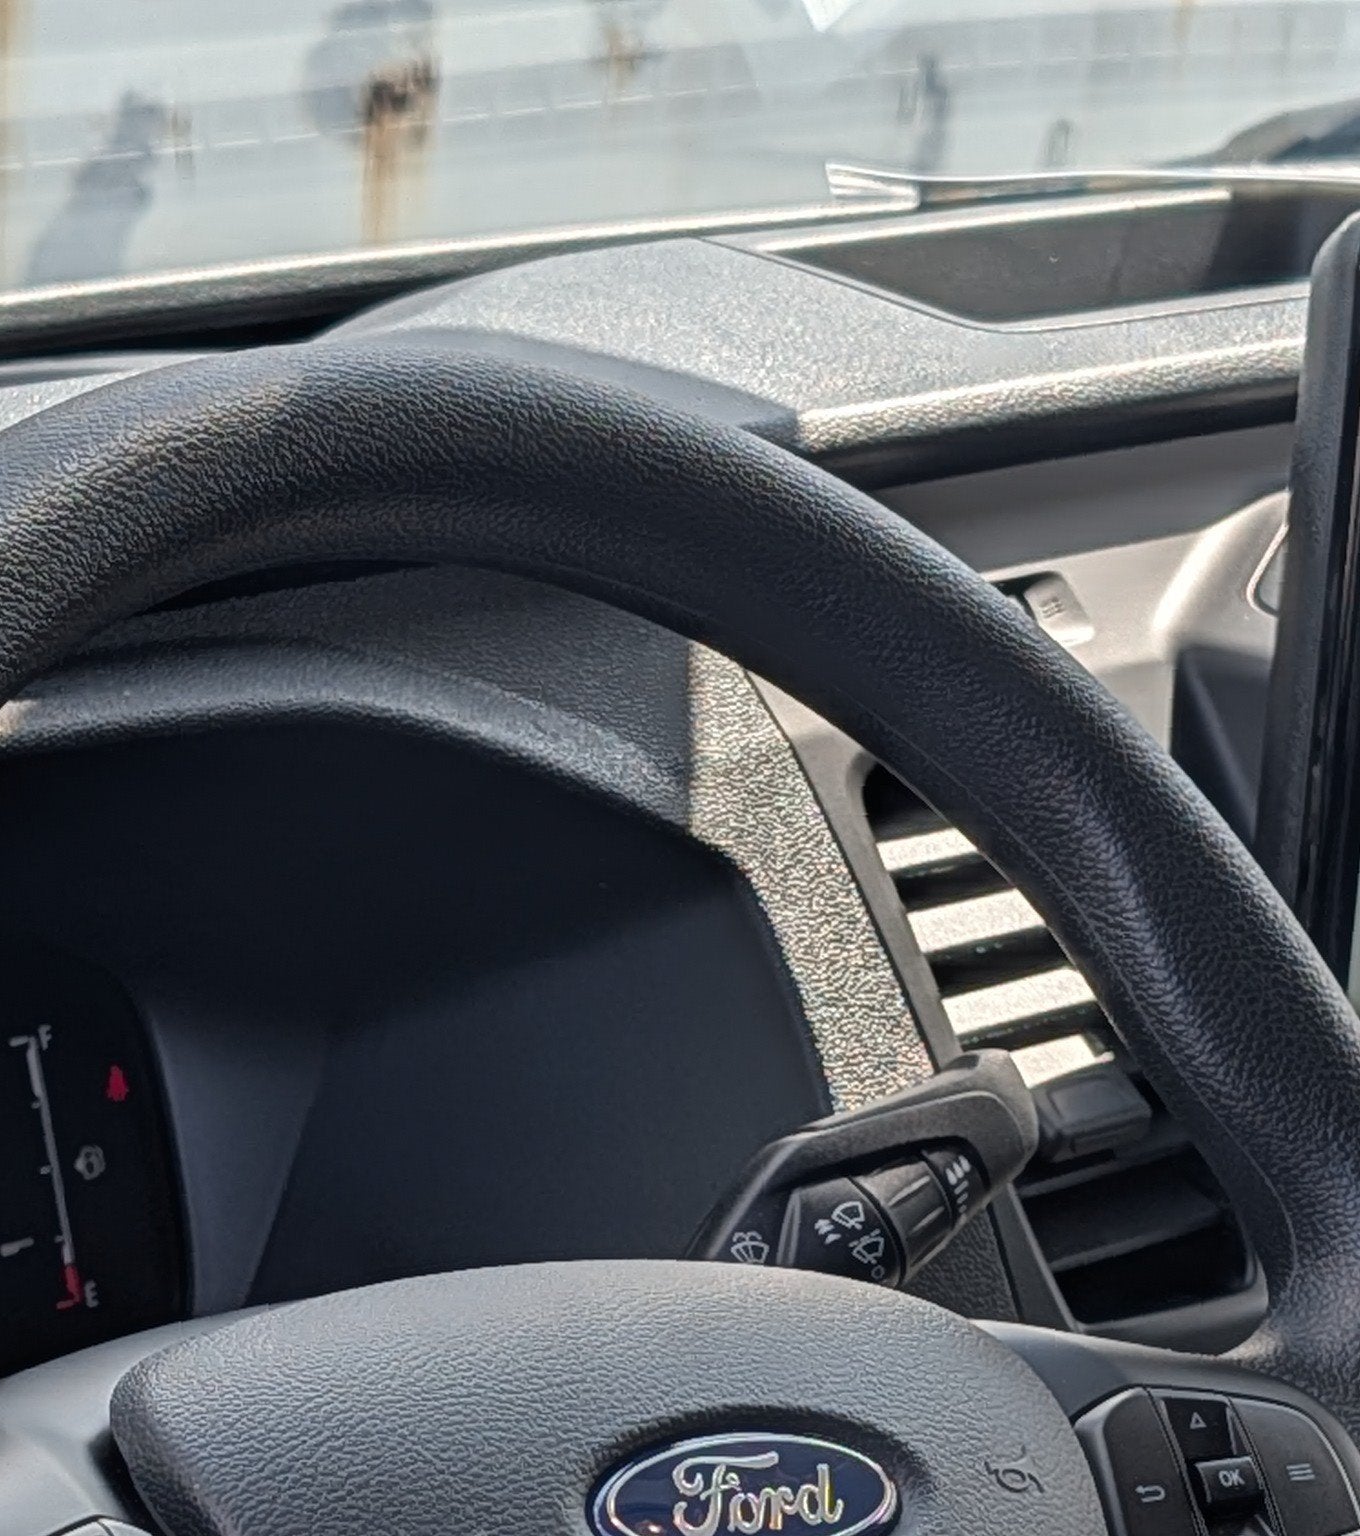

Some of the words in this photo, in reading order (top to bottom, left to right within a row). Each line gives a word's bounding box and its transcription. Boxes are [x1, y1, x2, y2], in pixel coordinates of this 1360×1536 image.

[38, 1024, 52, 1050] F
[84, 1281, 98, 1307] E
[1218, 1469, 1246, 1489] OK
